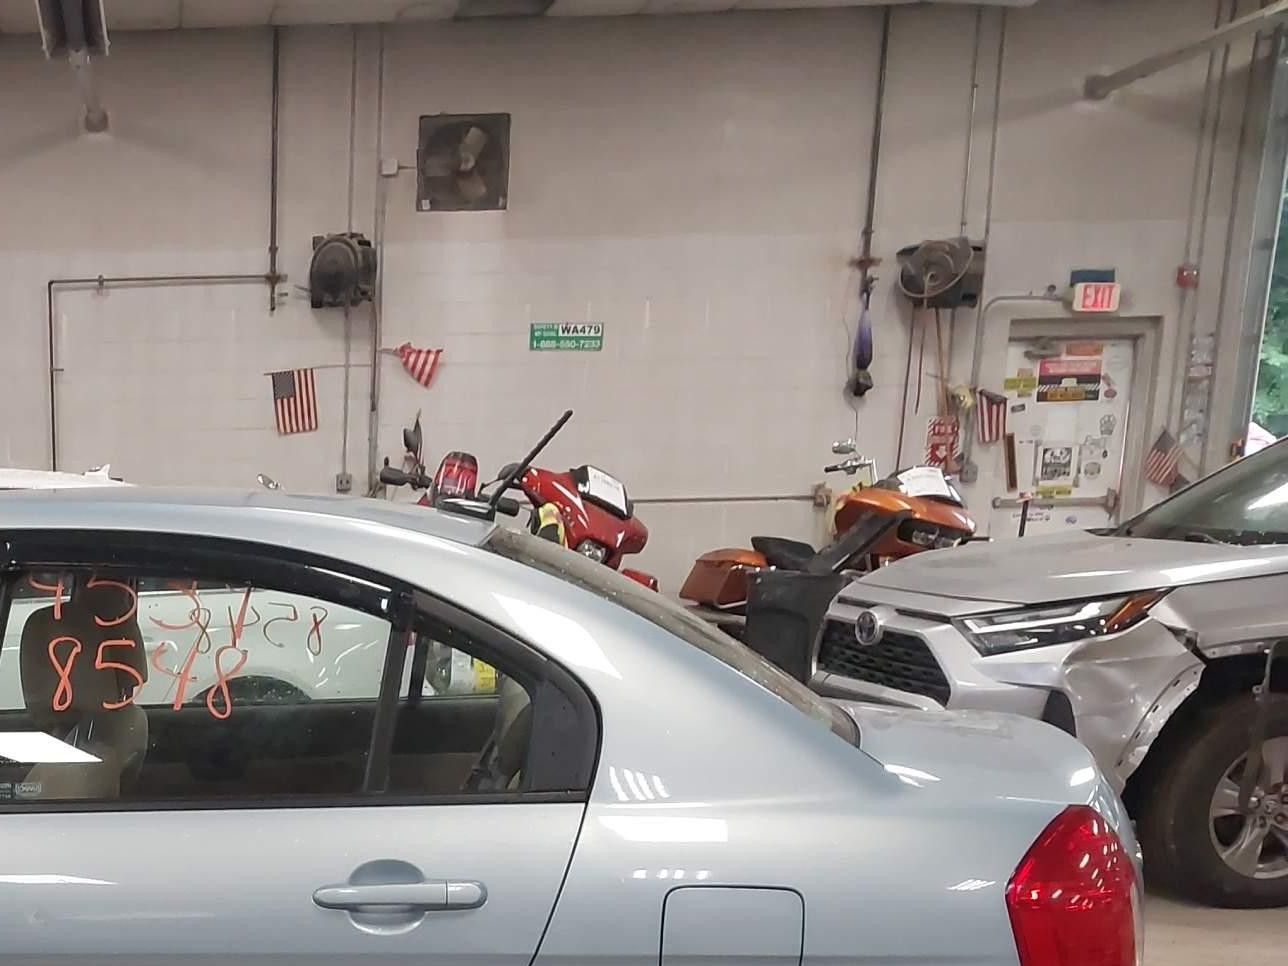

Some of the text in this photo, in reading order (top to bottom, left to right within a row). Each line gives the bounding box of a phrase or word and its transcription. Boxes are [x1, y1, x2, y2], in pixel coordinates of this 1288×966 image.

[1082, 285, 1114, 309] EXIT
[560, 324, 601, 335] WA479
[48, 636, 248, 720] 8548
